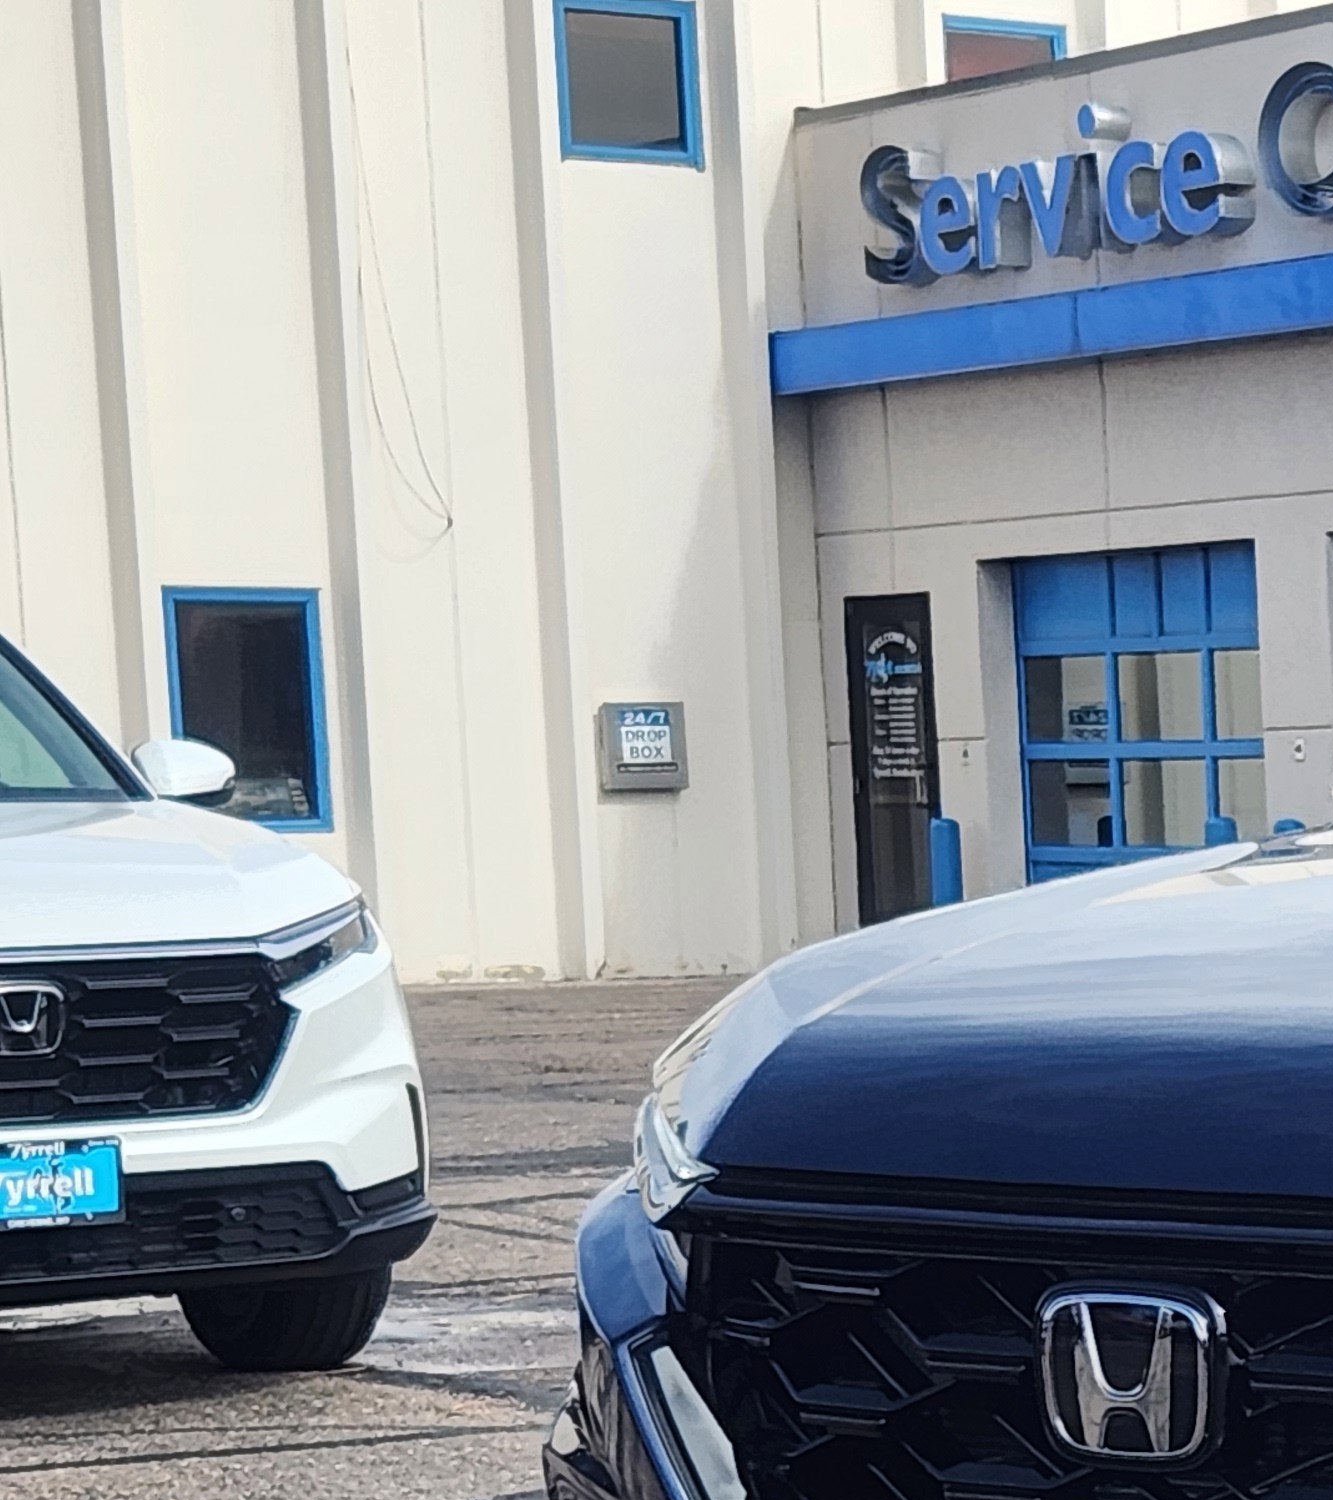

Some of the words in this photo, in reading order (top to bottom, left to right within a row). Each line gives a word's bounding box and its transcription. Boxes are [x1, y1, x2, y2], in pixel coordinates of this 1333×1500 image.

[860, 103, 1255, 285] Service
[624, 711, 666, 725] 24/7
[624, 730, 667, 743] DROP
[629, 745, 664, 759] BOX
